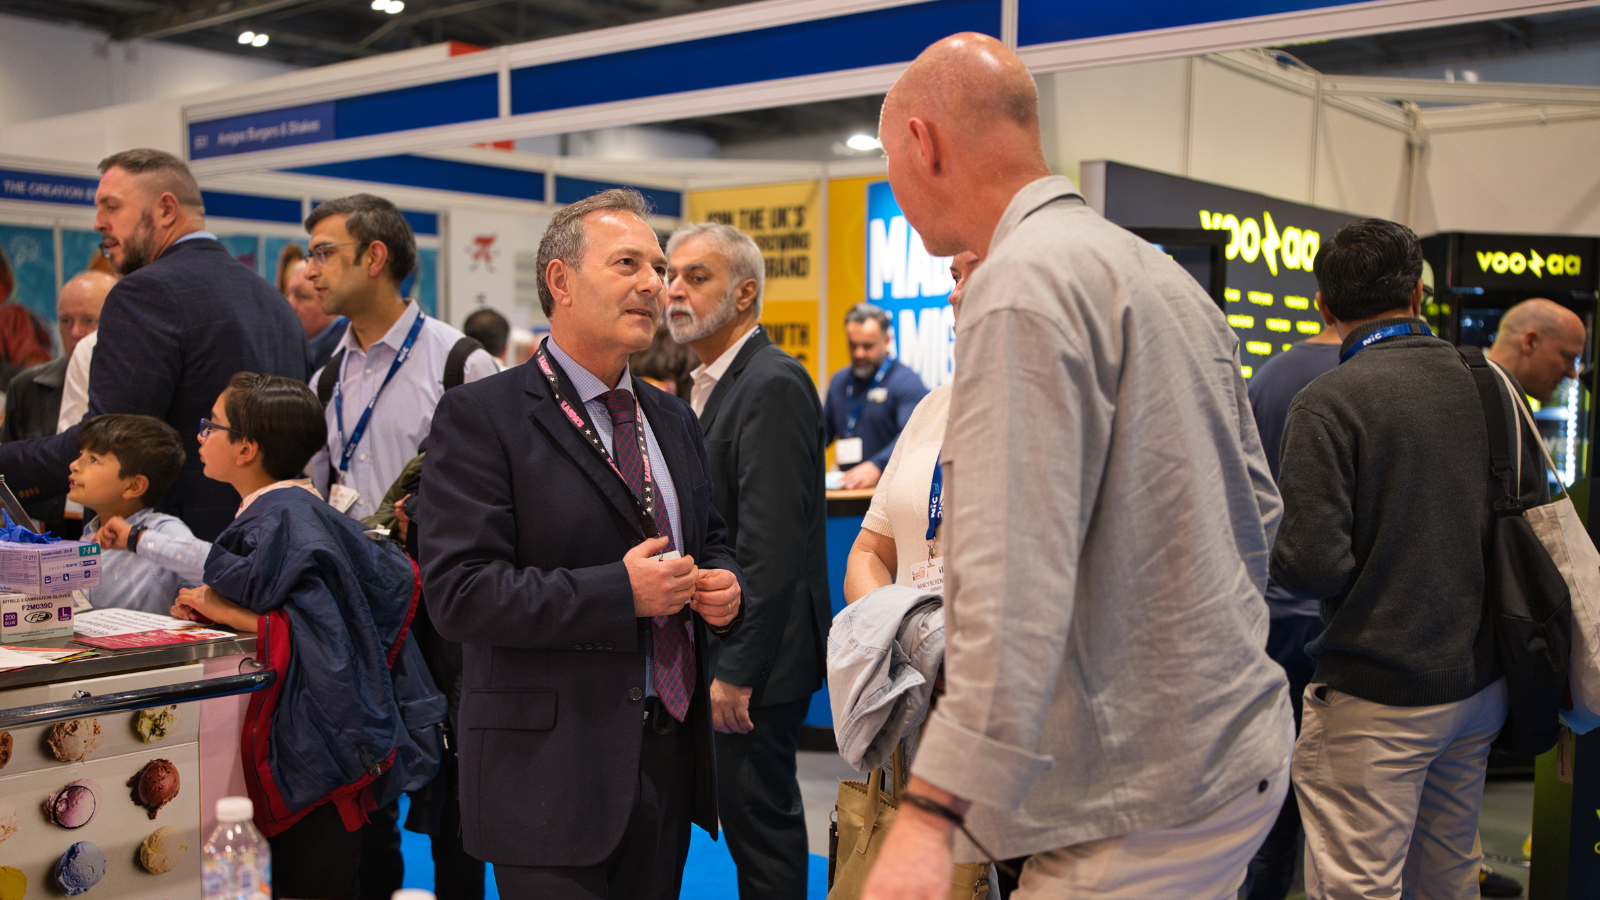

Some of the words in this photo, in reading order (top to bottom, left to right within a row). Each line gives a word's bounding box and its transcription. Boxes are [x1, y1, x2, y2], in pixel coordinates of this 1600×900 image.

[3, 180, 27, 195] THE
[28, 182, 84, 199] CREATION
[740, 208, 764, 230] THE
[21, 595, 52, 603] EXAMINATION
[21, 602, 53, 611] F2M039D
